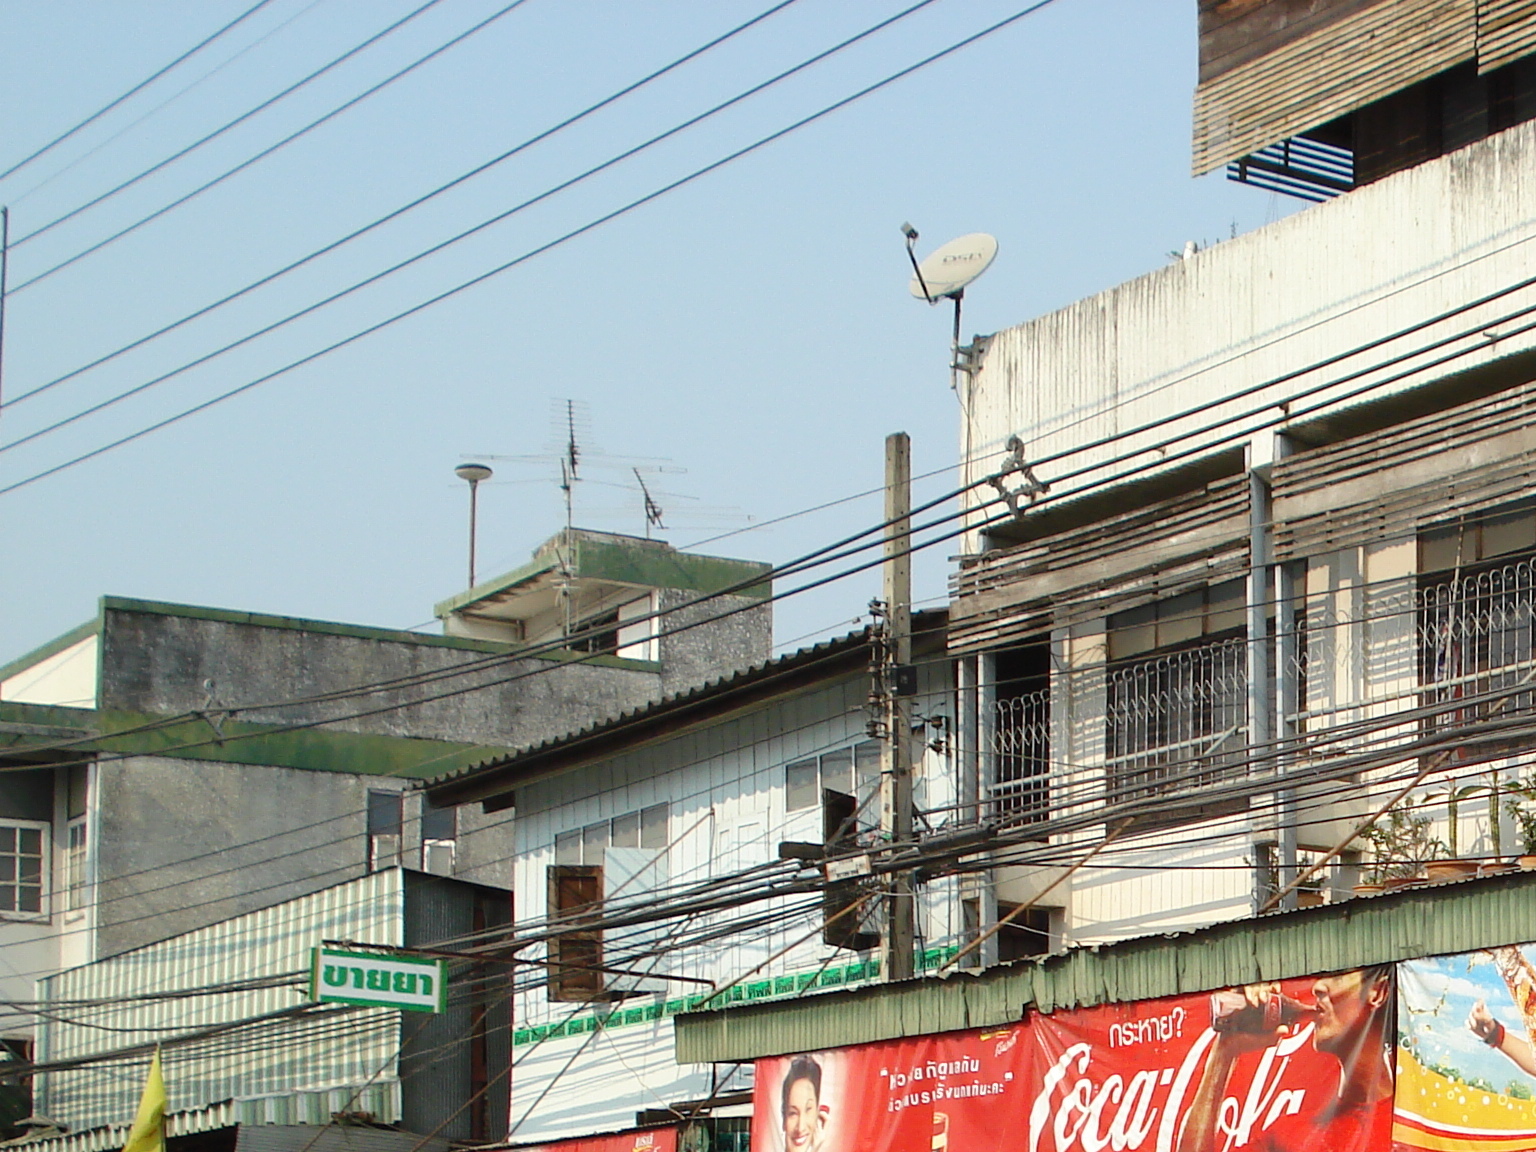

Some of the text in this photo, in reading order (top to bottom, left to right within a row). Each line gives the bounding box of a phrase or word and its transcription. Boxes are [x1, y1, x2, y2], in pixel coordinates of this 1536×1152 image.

[322, 964, 434, 996] ขายยา
[1109, 1007, 1185, 1048] กระหาย?
